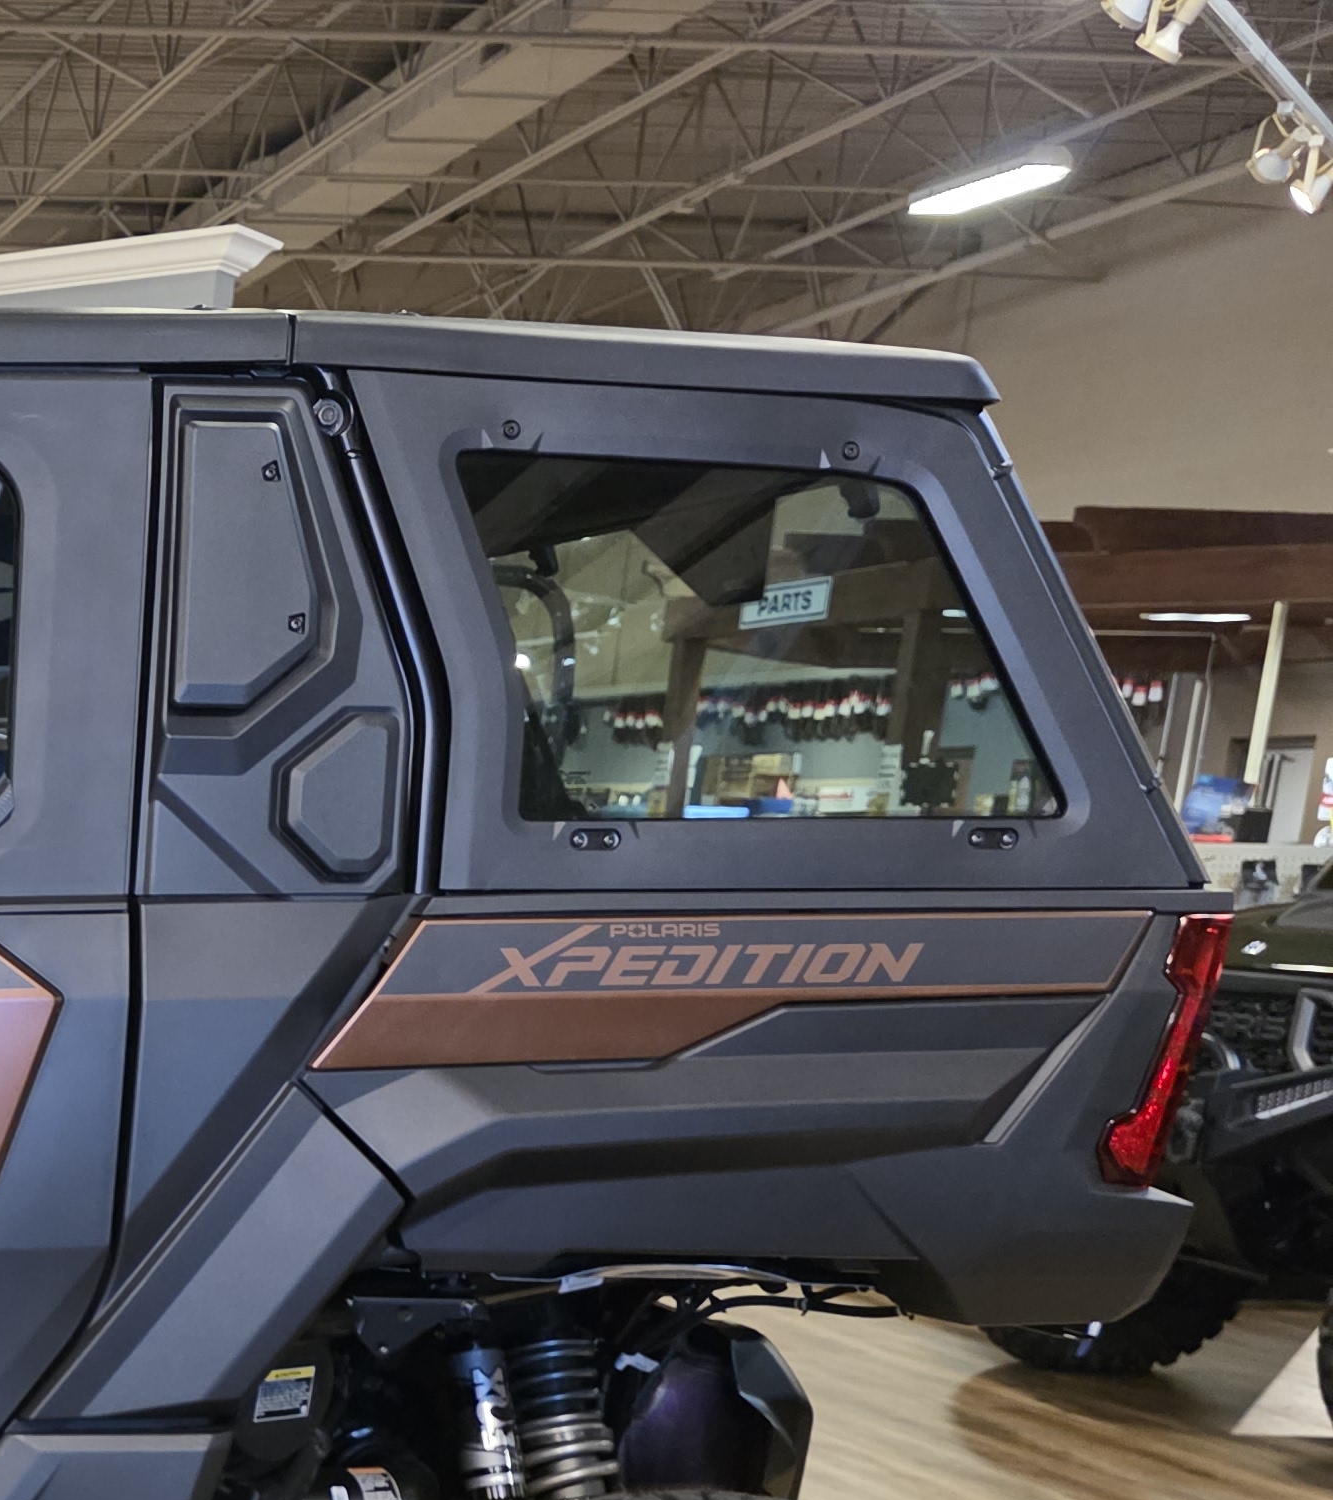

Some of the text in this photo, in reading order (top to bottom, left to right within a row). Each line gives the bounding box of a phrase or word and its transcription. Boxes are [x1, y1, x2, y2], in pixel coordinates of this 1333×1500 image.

[757, 590, 812, 617] PARTS
[609, 923, 720, 938] POLARIS
[466, 925, 923, 994] XPEDITION
